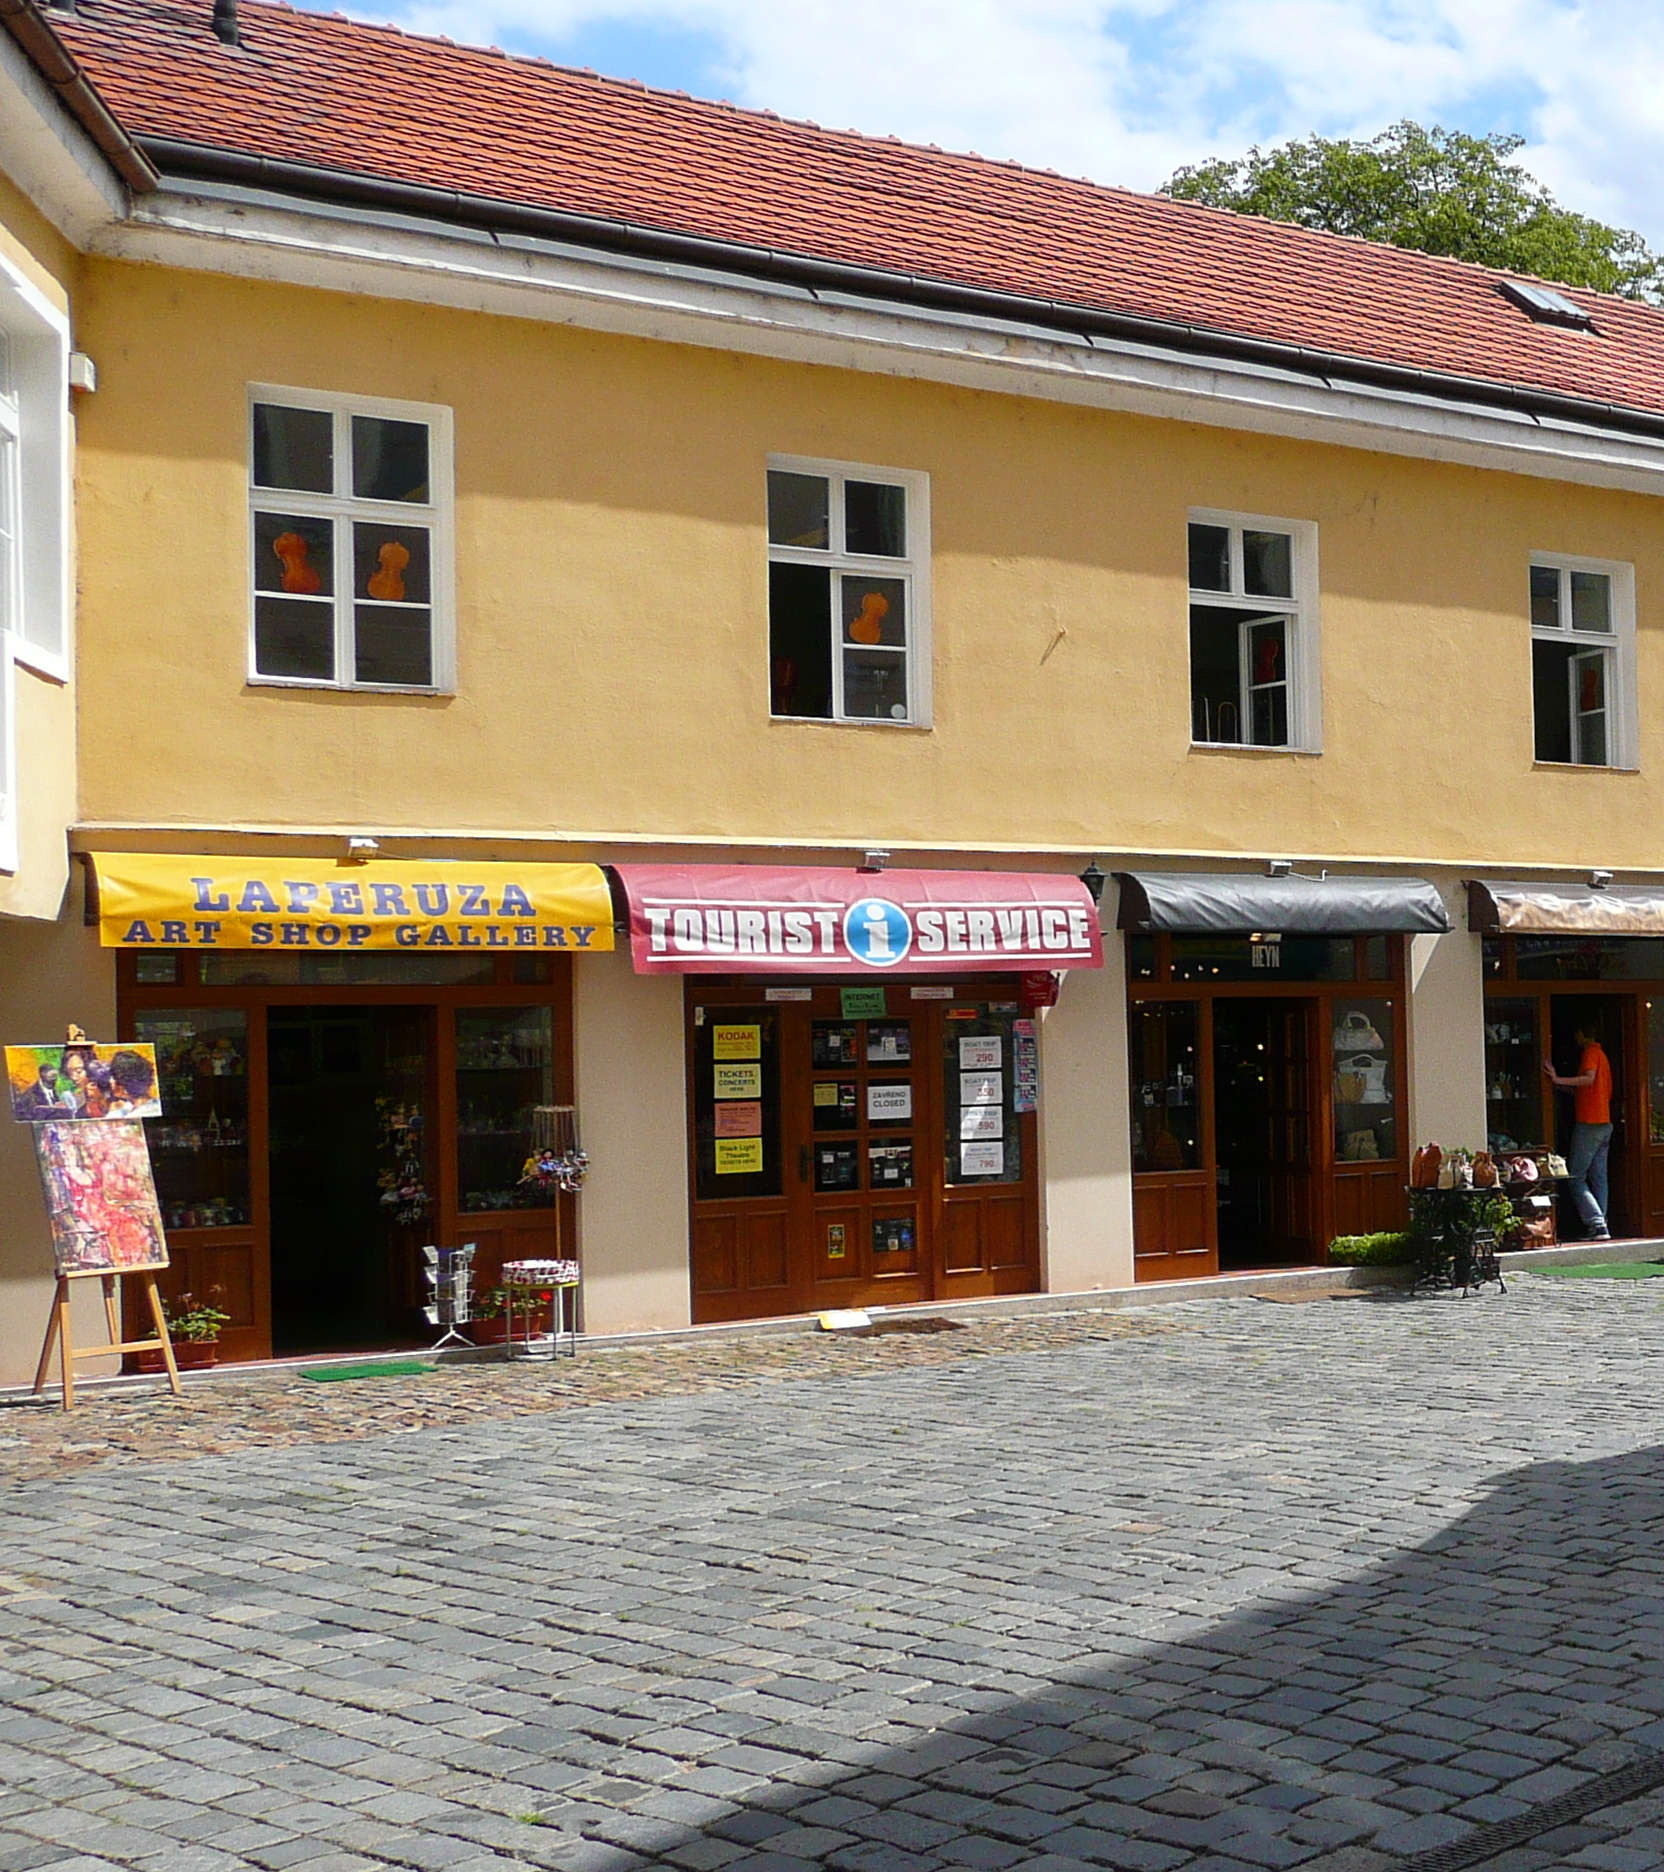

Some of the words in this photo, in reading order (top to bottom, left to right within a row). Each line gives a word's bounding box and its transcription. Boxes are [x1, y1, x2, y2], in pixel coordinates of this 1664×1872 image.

[190, 878, 536, 916] LAPERUZA
[122, 919, 221, 944] ART
[251, 922, 371, 946] SHOP
[395, 925, 596, 947] GALLERY
[645, 908, 838, 954] TOURIST
[916, 909, 1090, 952] SERVICE
[718, 1031, 755, 1040] KODAK
[976, 1053, 993, 1062] 290
[873, 1100, 905, 1108] CLOSED
